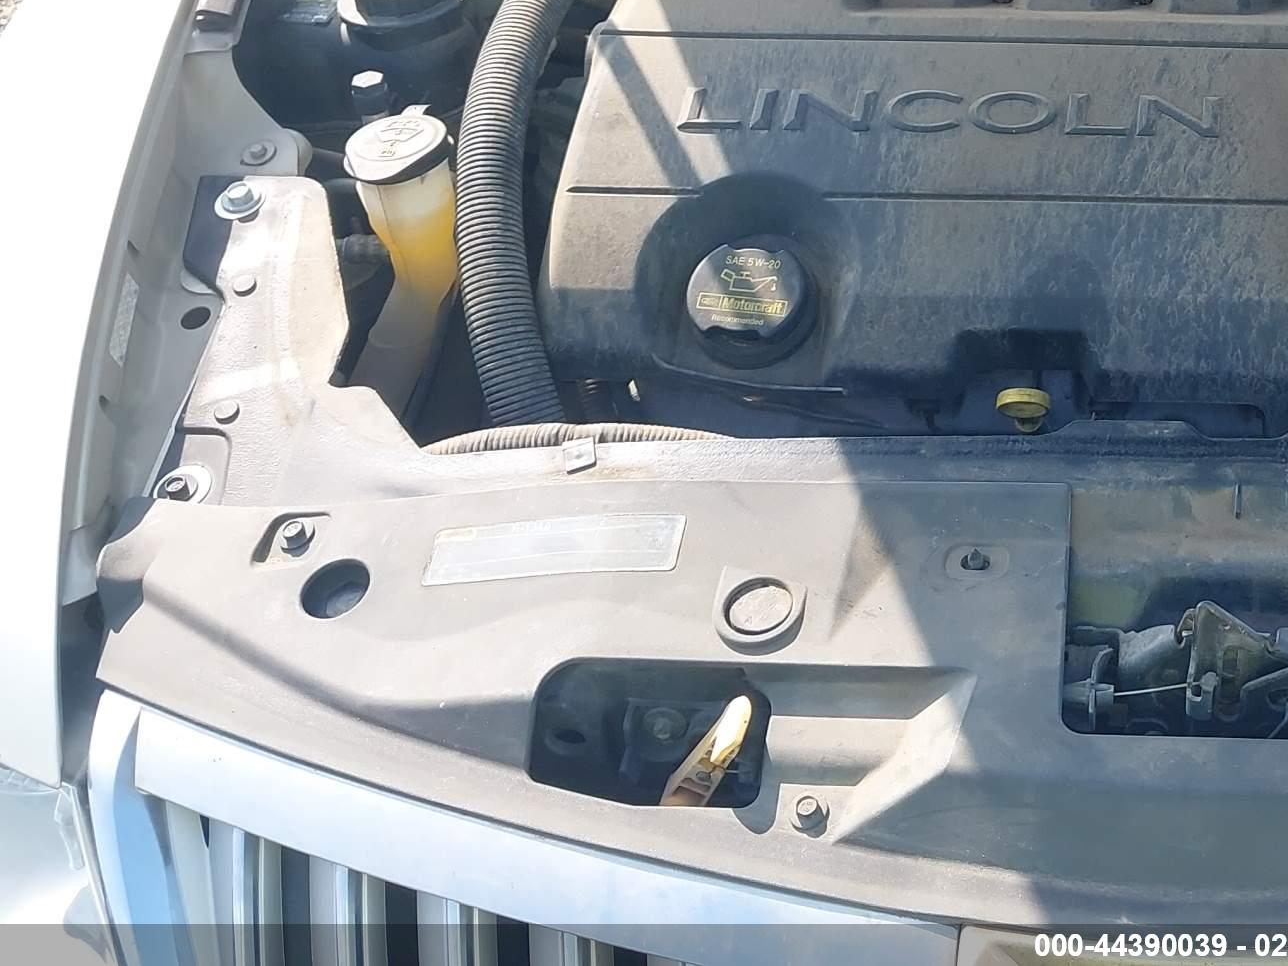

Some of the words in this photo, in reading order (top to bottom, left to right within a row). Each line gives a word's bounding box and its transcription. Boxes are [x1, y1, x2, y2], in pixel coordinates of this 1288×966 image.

[676, 86, 1223, 138] LINCOLN
[725, 255, 745, 266] SAE
[746, 257, 781, 269] 5W-20
[721, 296, 783, 314] Motorcraft
[711, 313, 764, 326] Recommended
